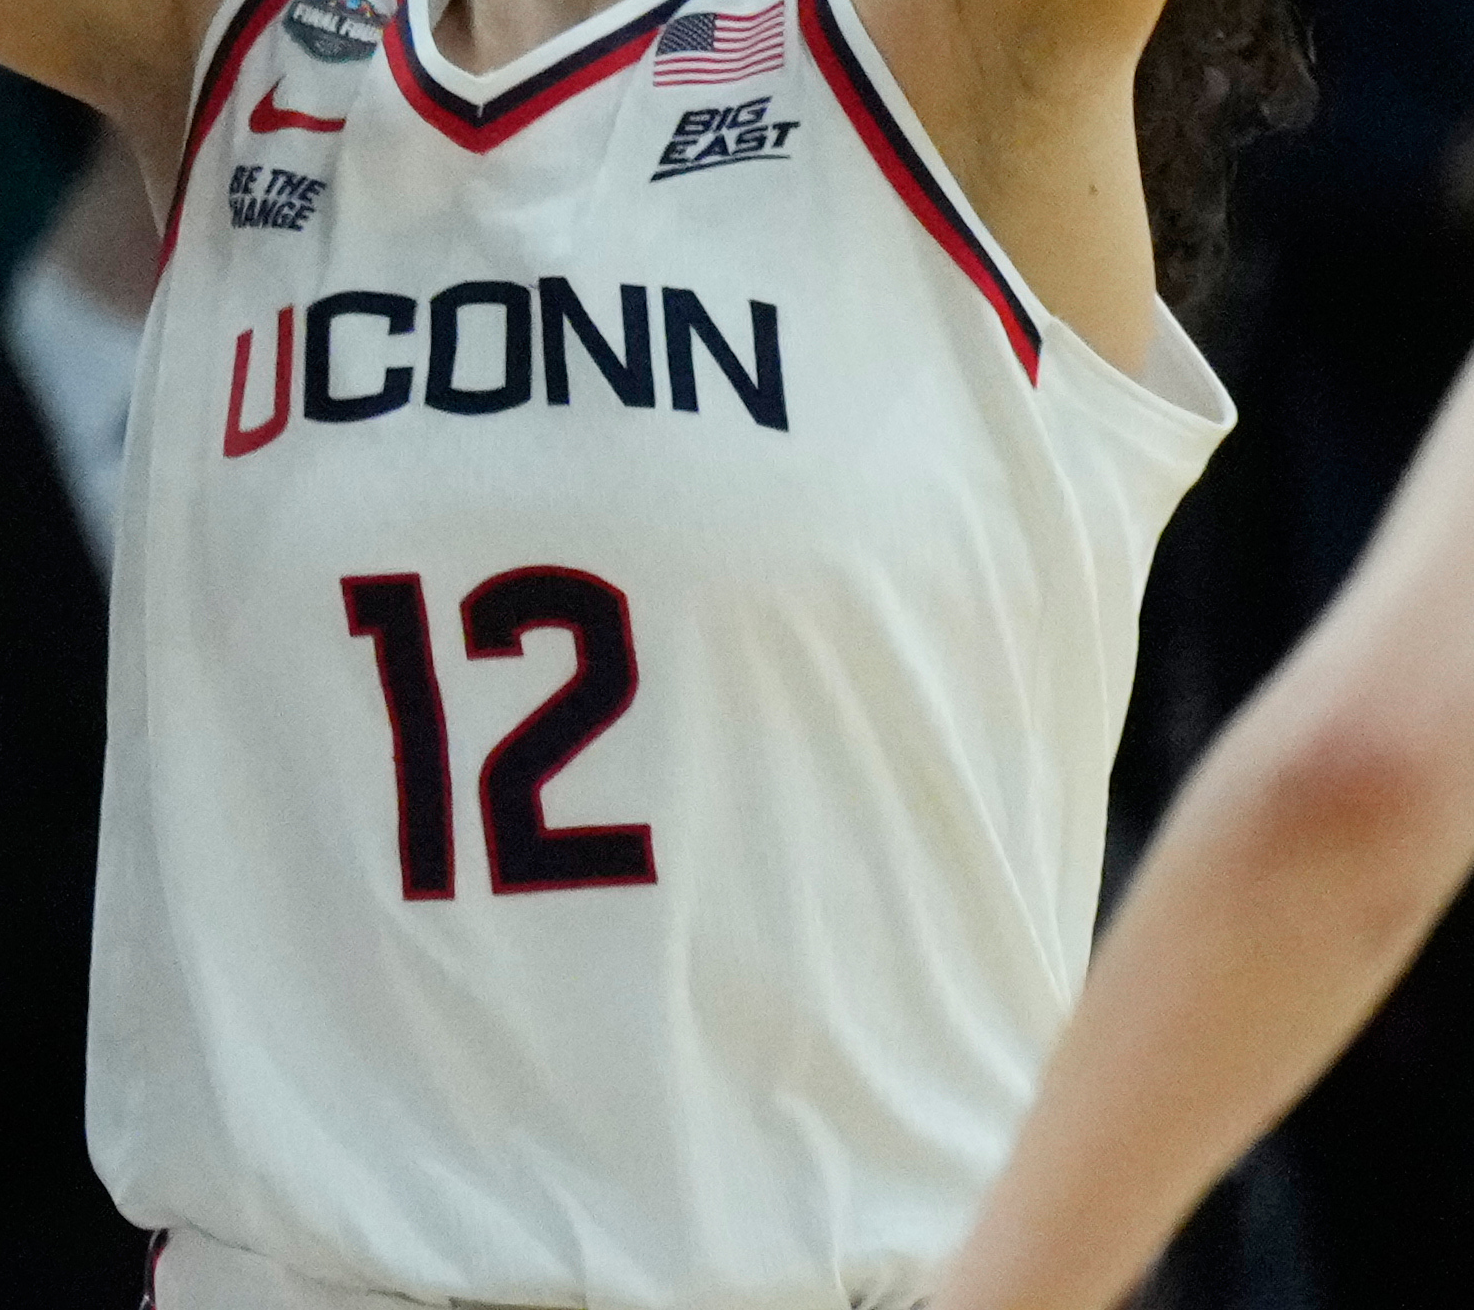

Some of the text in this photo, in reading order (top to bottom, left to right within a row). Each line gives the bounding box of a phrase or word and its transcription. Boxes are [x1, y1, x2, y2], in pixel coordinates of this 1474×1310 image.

[293, 1, 340, 33] FINAL
[674, 96, 772, 138] BIG
[659, 121, 801, 165] EAST
[229, 165, 327, 203] BE THE
[222, 275, 789, 457] UCONN
[340, 565, 658, 900] 12
